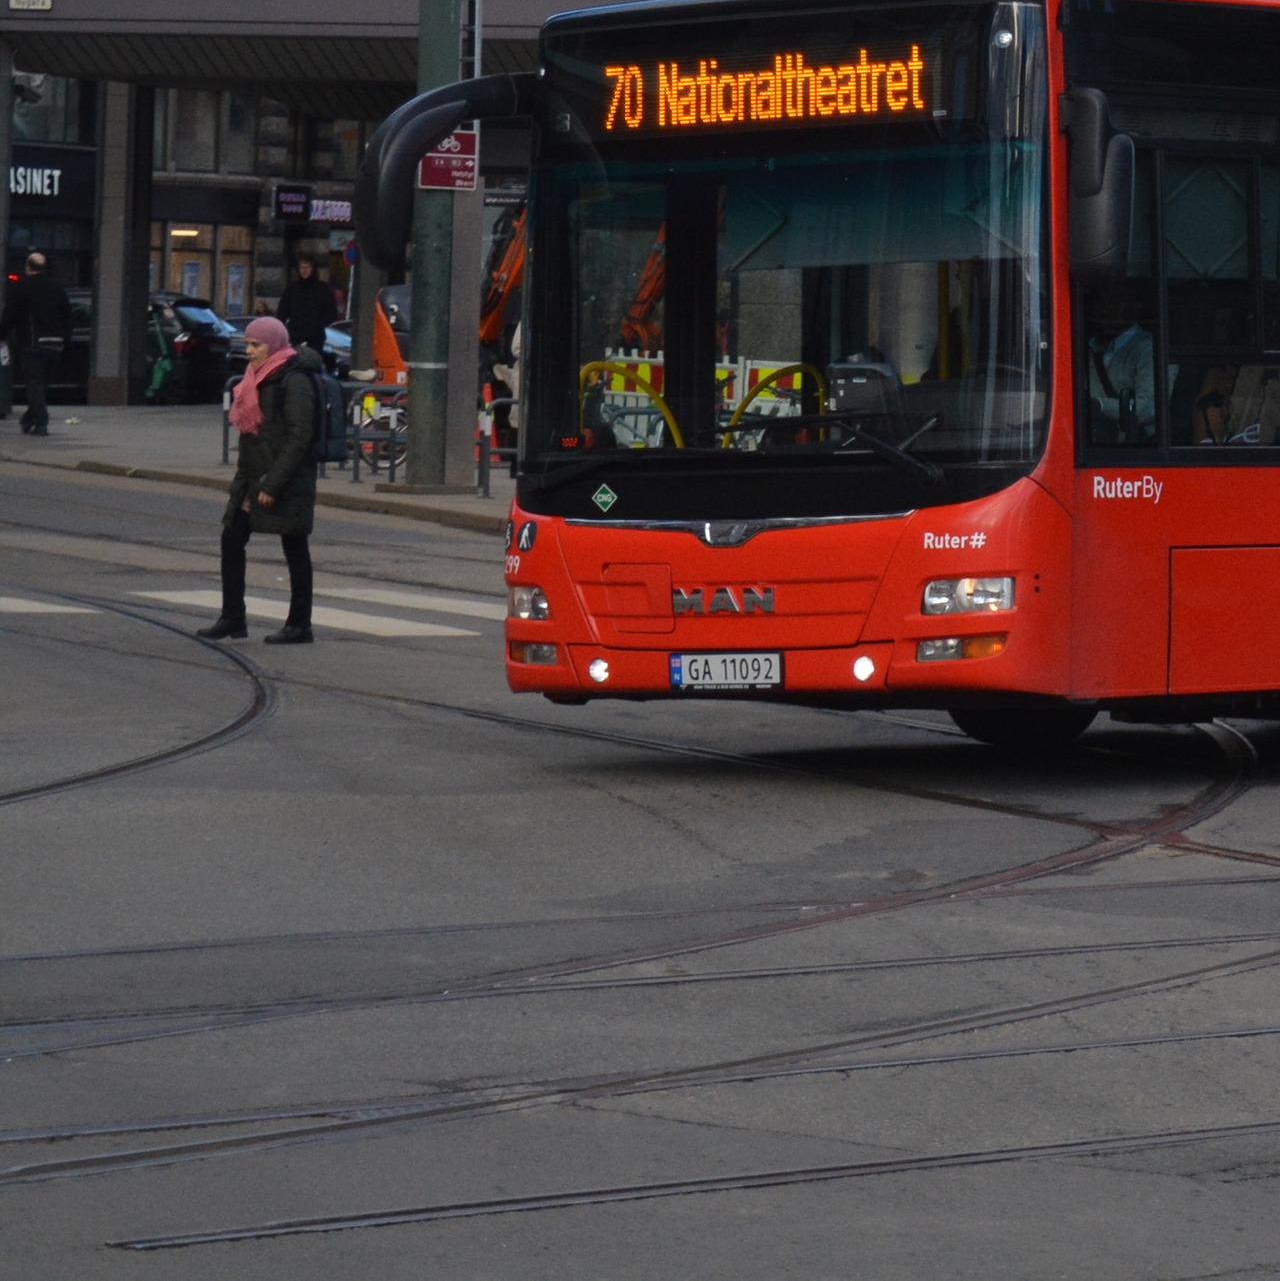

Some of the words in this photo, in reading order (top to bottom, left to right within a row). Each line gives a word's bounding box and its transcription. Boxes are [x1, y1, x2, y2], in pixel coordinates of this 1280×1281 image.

[605, 65, 643, 129] 70
[658, 45, 924, 126] Nationaltheatret
[596, 494, 613, 503] CNG
[1093, 475, 1163, 503] RuterBy
[673, 586, 774, 614] MAN
[688, 659, 713, 681] GA
[721, 658, 773, 680] 11092
